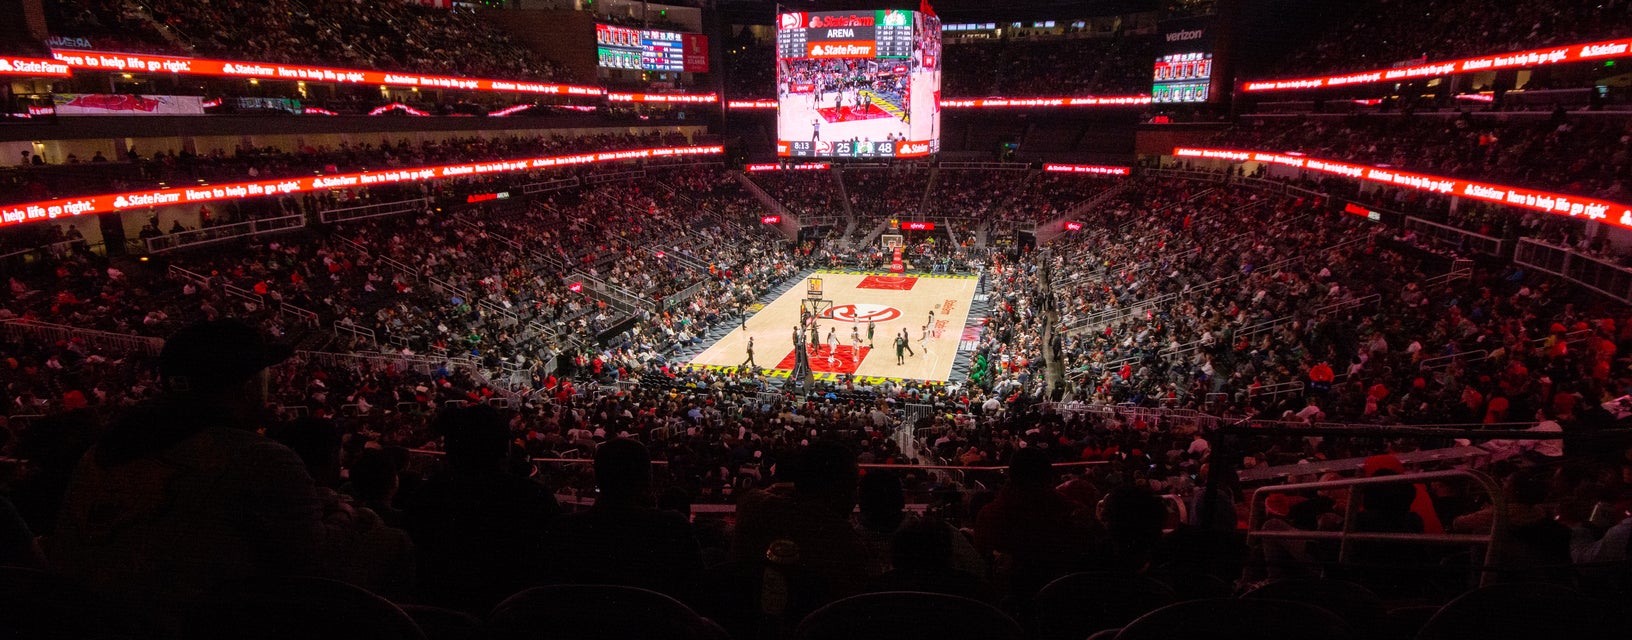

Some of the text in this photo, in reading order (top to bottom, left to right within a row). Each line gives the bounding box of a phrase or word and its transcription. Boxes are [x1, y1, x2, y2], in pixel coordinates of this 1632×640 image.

[827, 28, 854, 38] ARENA
[1166, 29, 1202, 41] verizon
[85, 56, 98, 66] to
[100, 56, 125, 69] help
[127, 58, 145, 68] life
[147, 61, 161, 71] go
[299, 69, 307, 78] to
[308, 69, 323, 80] help
[337, 73, 346, 81] go
[794, 142, 810, 150] 8:13
[837, 143, 850, 153] 25
[878, 143, 892, 153] 48
[186, 190, 211, 200] Here
[213, 189, 224, 197] to
[226, 186, 247, 197] help
[248, 184, 263, 194] life
[264, 185, 276, 194] go
[1526, 195, 1535, 205] to
[1536, 195, 1554, 211] help
[1570, 203, 1584, 215] go
[3, 209, 25, 222] help
[27, 206, 45, 218] life
[48, 206, 62, 218] go
